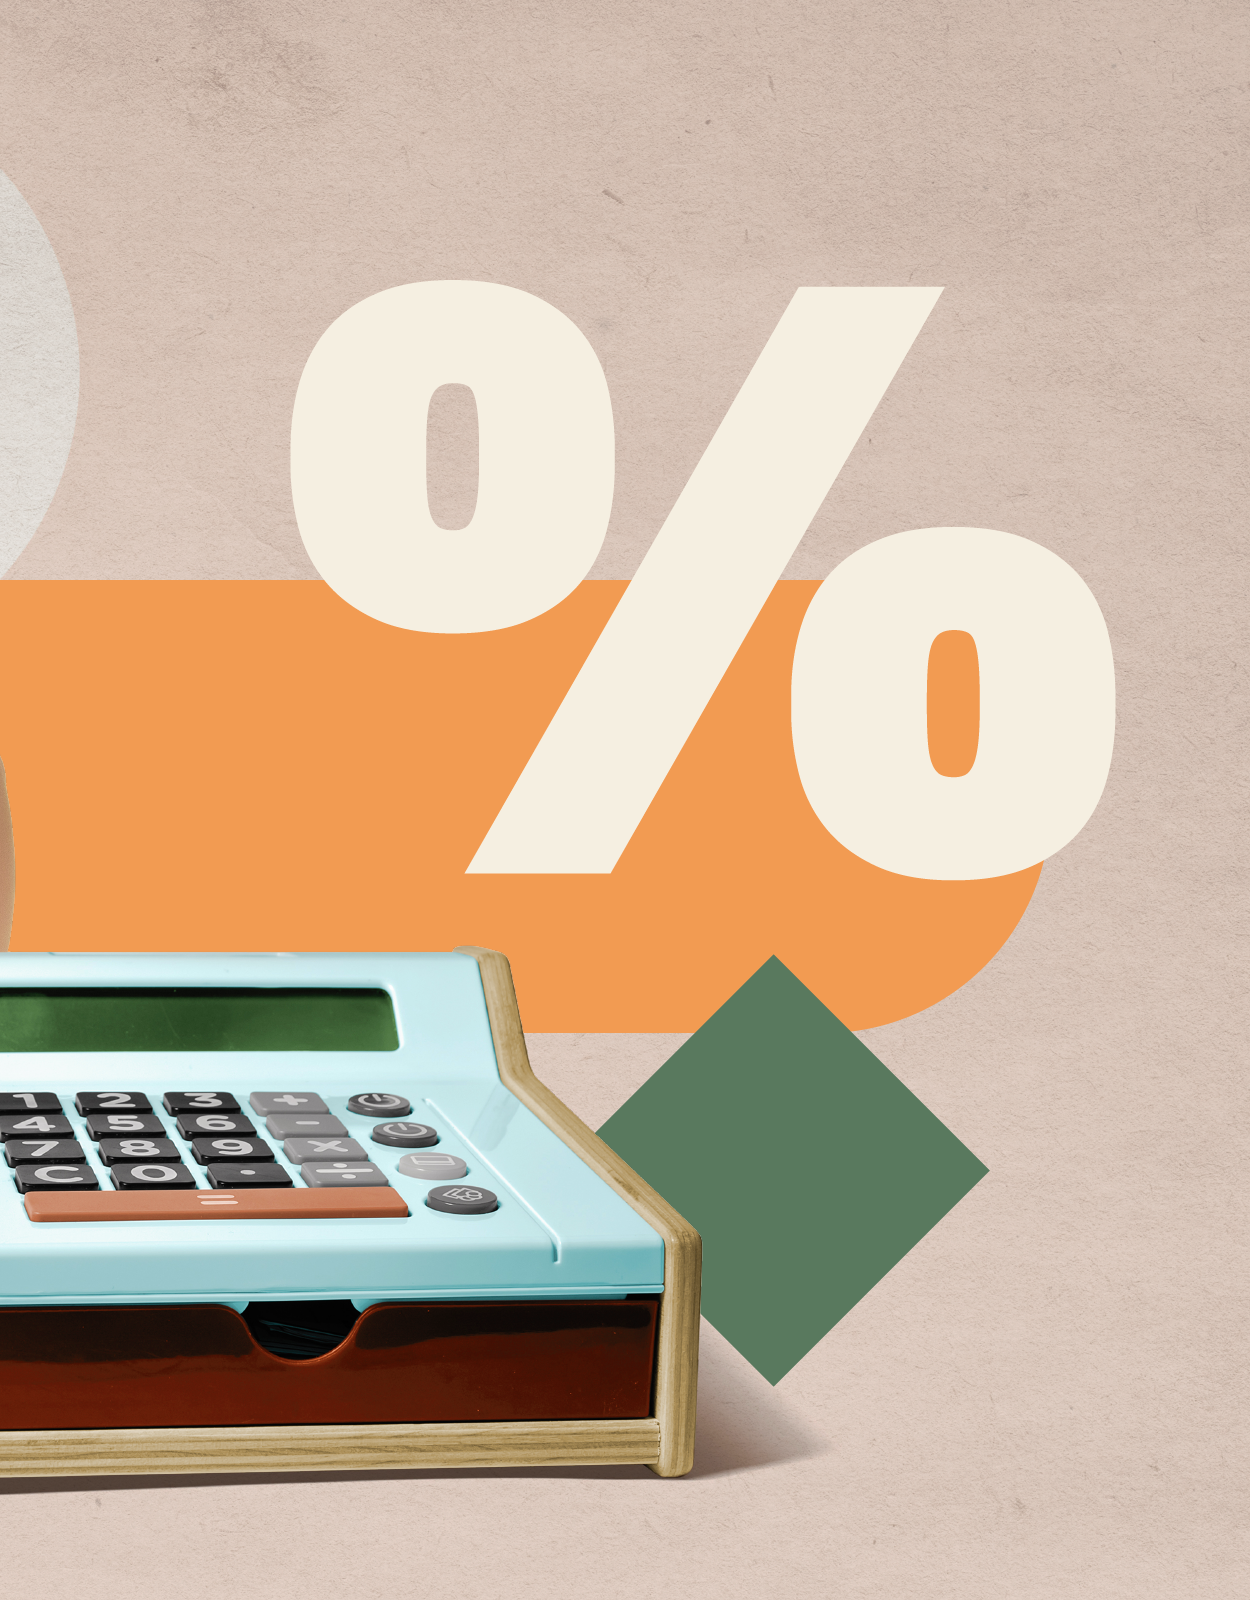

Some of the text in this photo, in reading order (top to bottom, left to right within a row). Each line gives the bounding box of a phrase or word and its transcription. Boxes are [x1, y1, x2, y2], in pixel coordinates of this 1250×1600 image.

[291, 280, 1116, 881] %
[12, 1093, 37, 1108] 1
[97, 1093, 136, 1108] 2
[184, 1093, 223, 1108] 3
[12, 1116, 56, 1132] 4
[107, 1115, 145, 1131] 5
[196, 1115, 237, 1131] 6
[22, 1140, 60, 1157] 7
[119, 1139, 161, 1156] 8
[211, 1139, 253, 1156] 9
[34, 1166, 83, 1183] C
